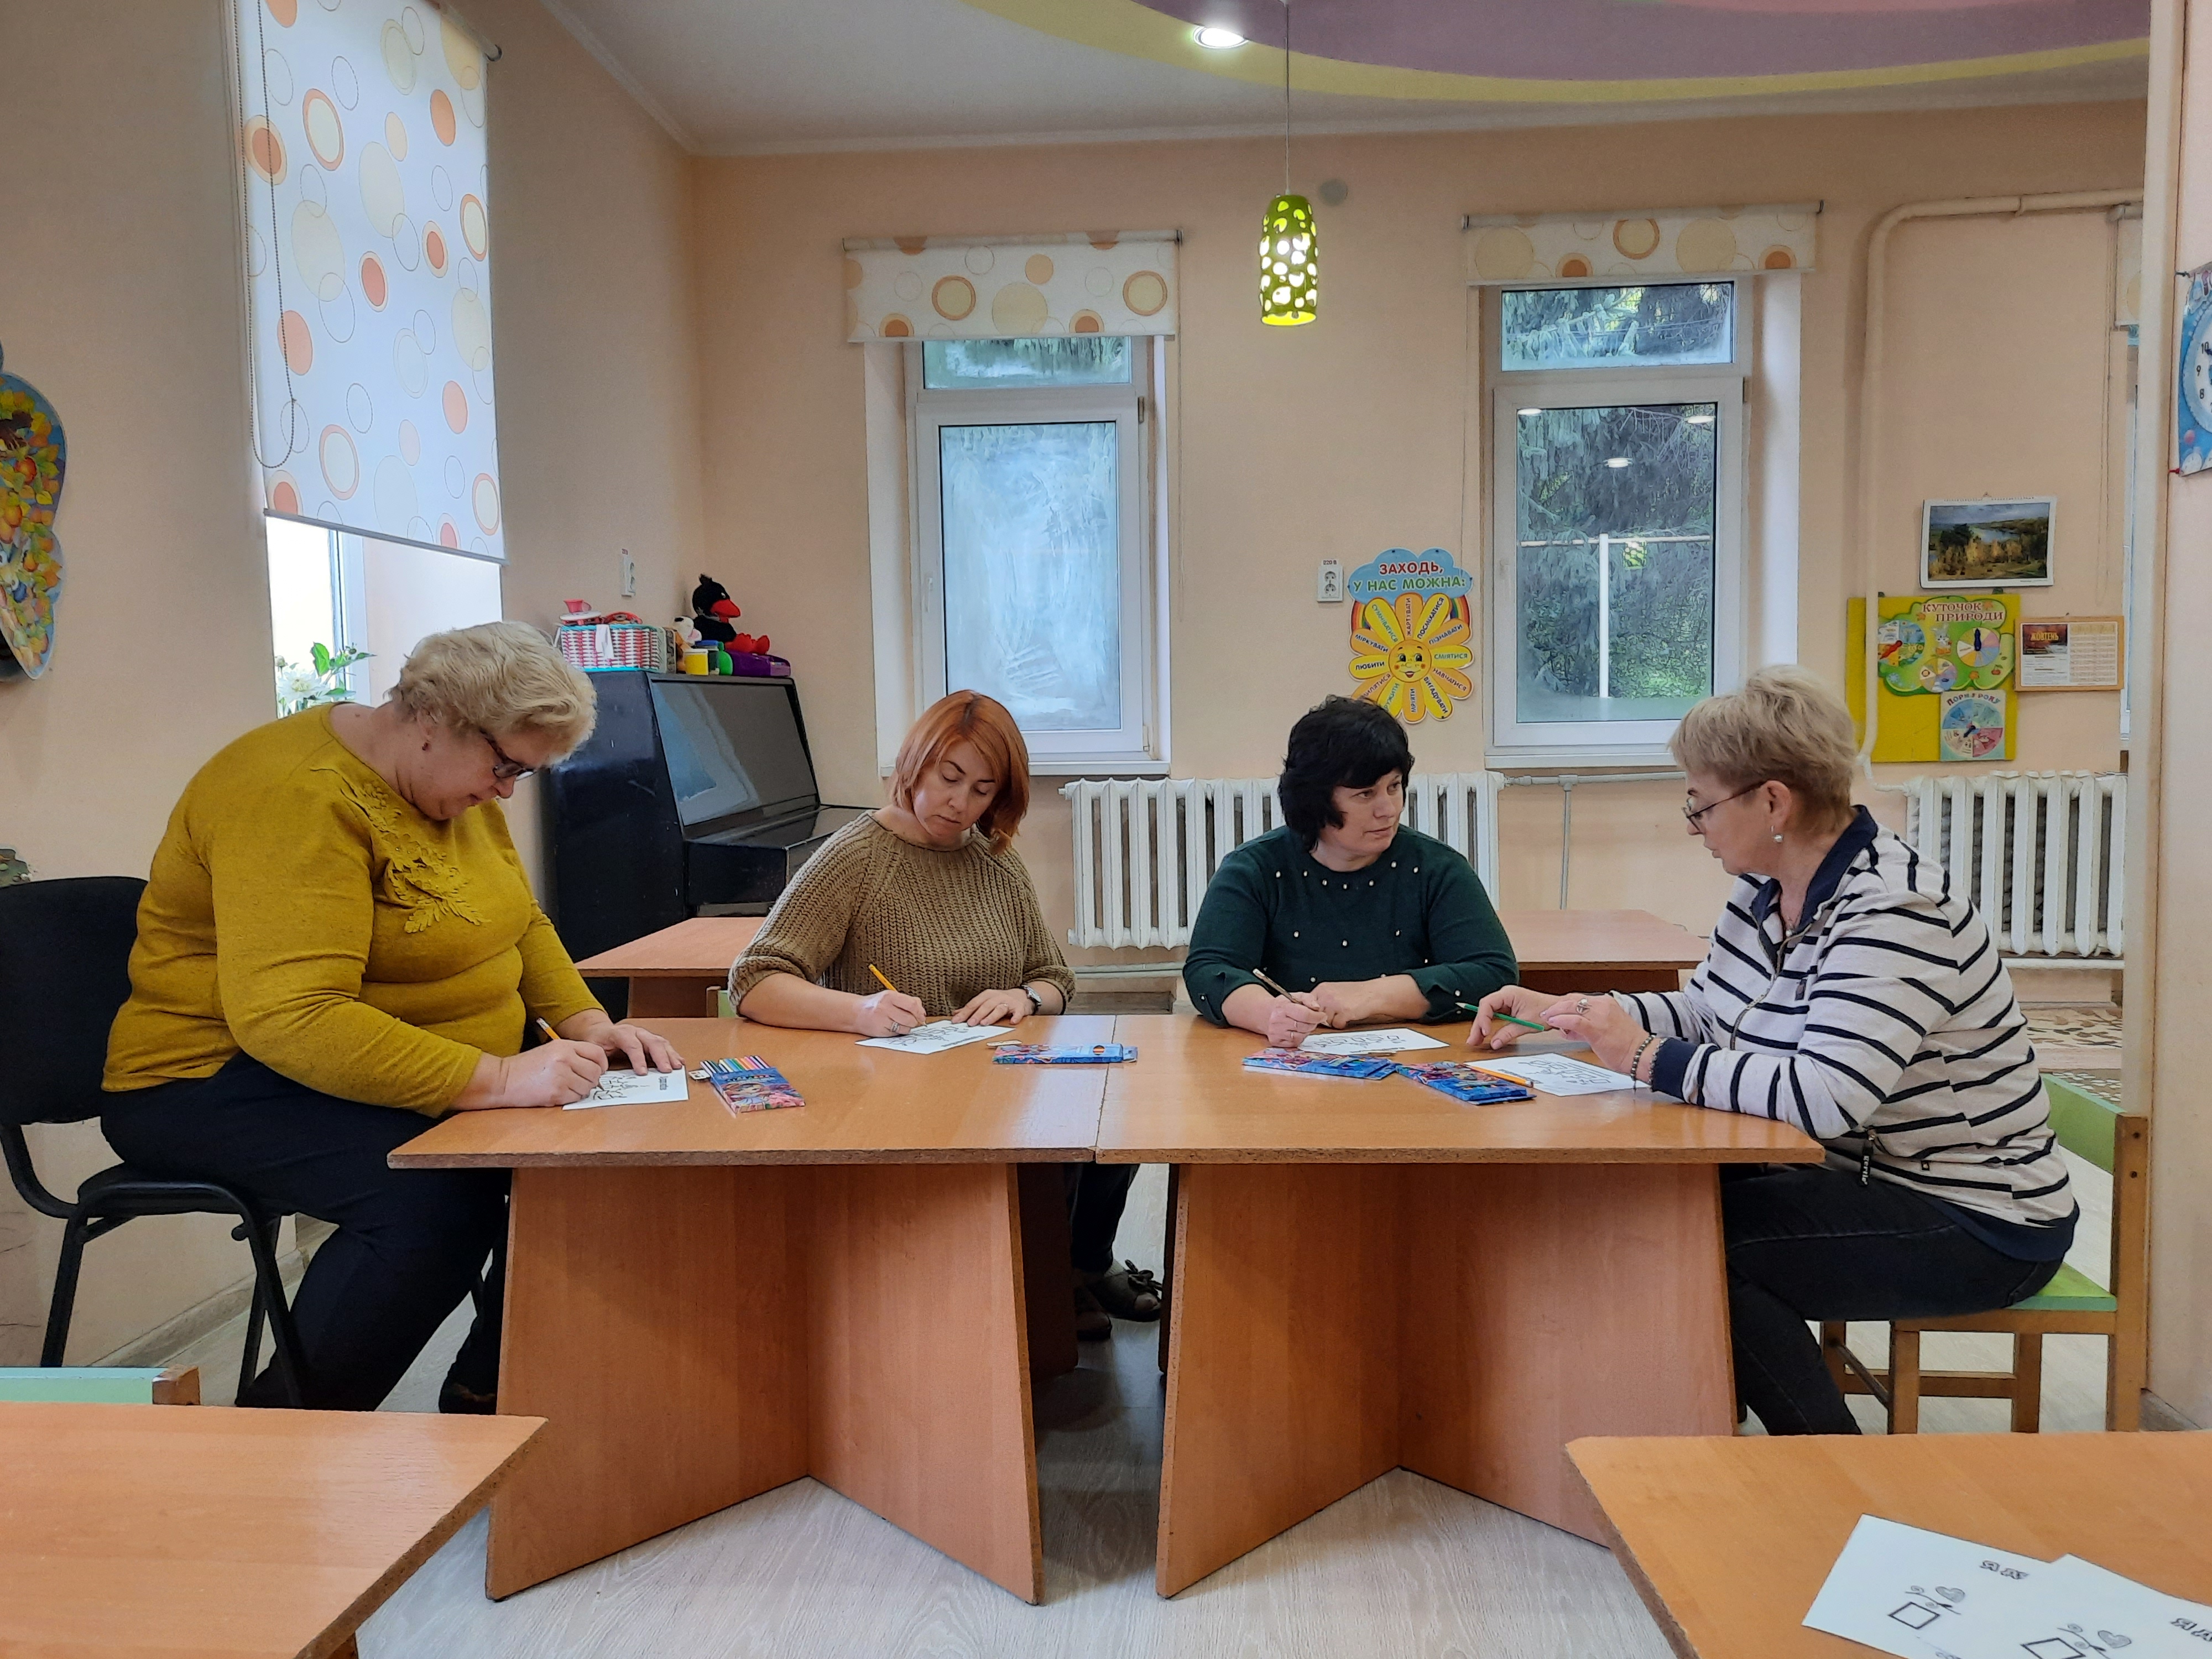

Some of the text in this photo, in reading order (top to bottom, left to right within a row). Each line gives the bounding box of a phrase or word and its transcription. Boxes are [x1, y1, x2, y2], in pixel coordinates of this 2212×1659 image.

[2197, 365, 2201, 376] 9
[2199, 388, 2205, 399] 8
[1379, 562, 1443, 575] ЗАХОДЬ,
[1353, 576, 1465, 592] У НАС МОЖНА:
[1923, 602, 1981, 612] КУТОЧОК
[1372, 604, 1398, 642] СУМНІВАТИСЯ
[1417, 597, 1444, 639] ПОСМІХАТИСЯ
[1936, 612, 2004, 622] ПРИРОДИ
[1428, 624, 1463, 644] ПІЗНАВАТИ
[1354, 634, 1389, 653] МІРКУВАТИ
[1355, 661, 1385, 670] ЛЮБИТИ
[1432, 668, 1467, 691] НАВЧАТИСЯ
[1384, 682, 1400, 711] РУЖИТИ
[1423, 676, 1448, 713] ВИГАДУВАТИ
